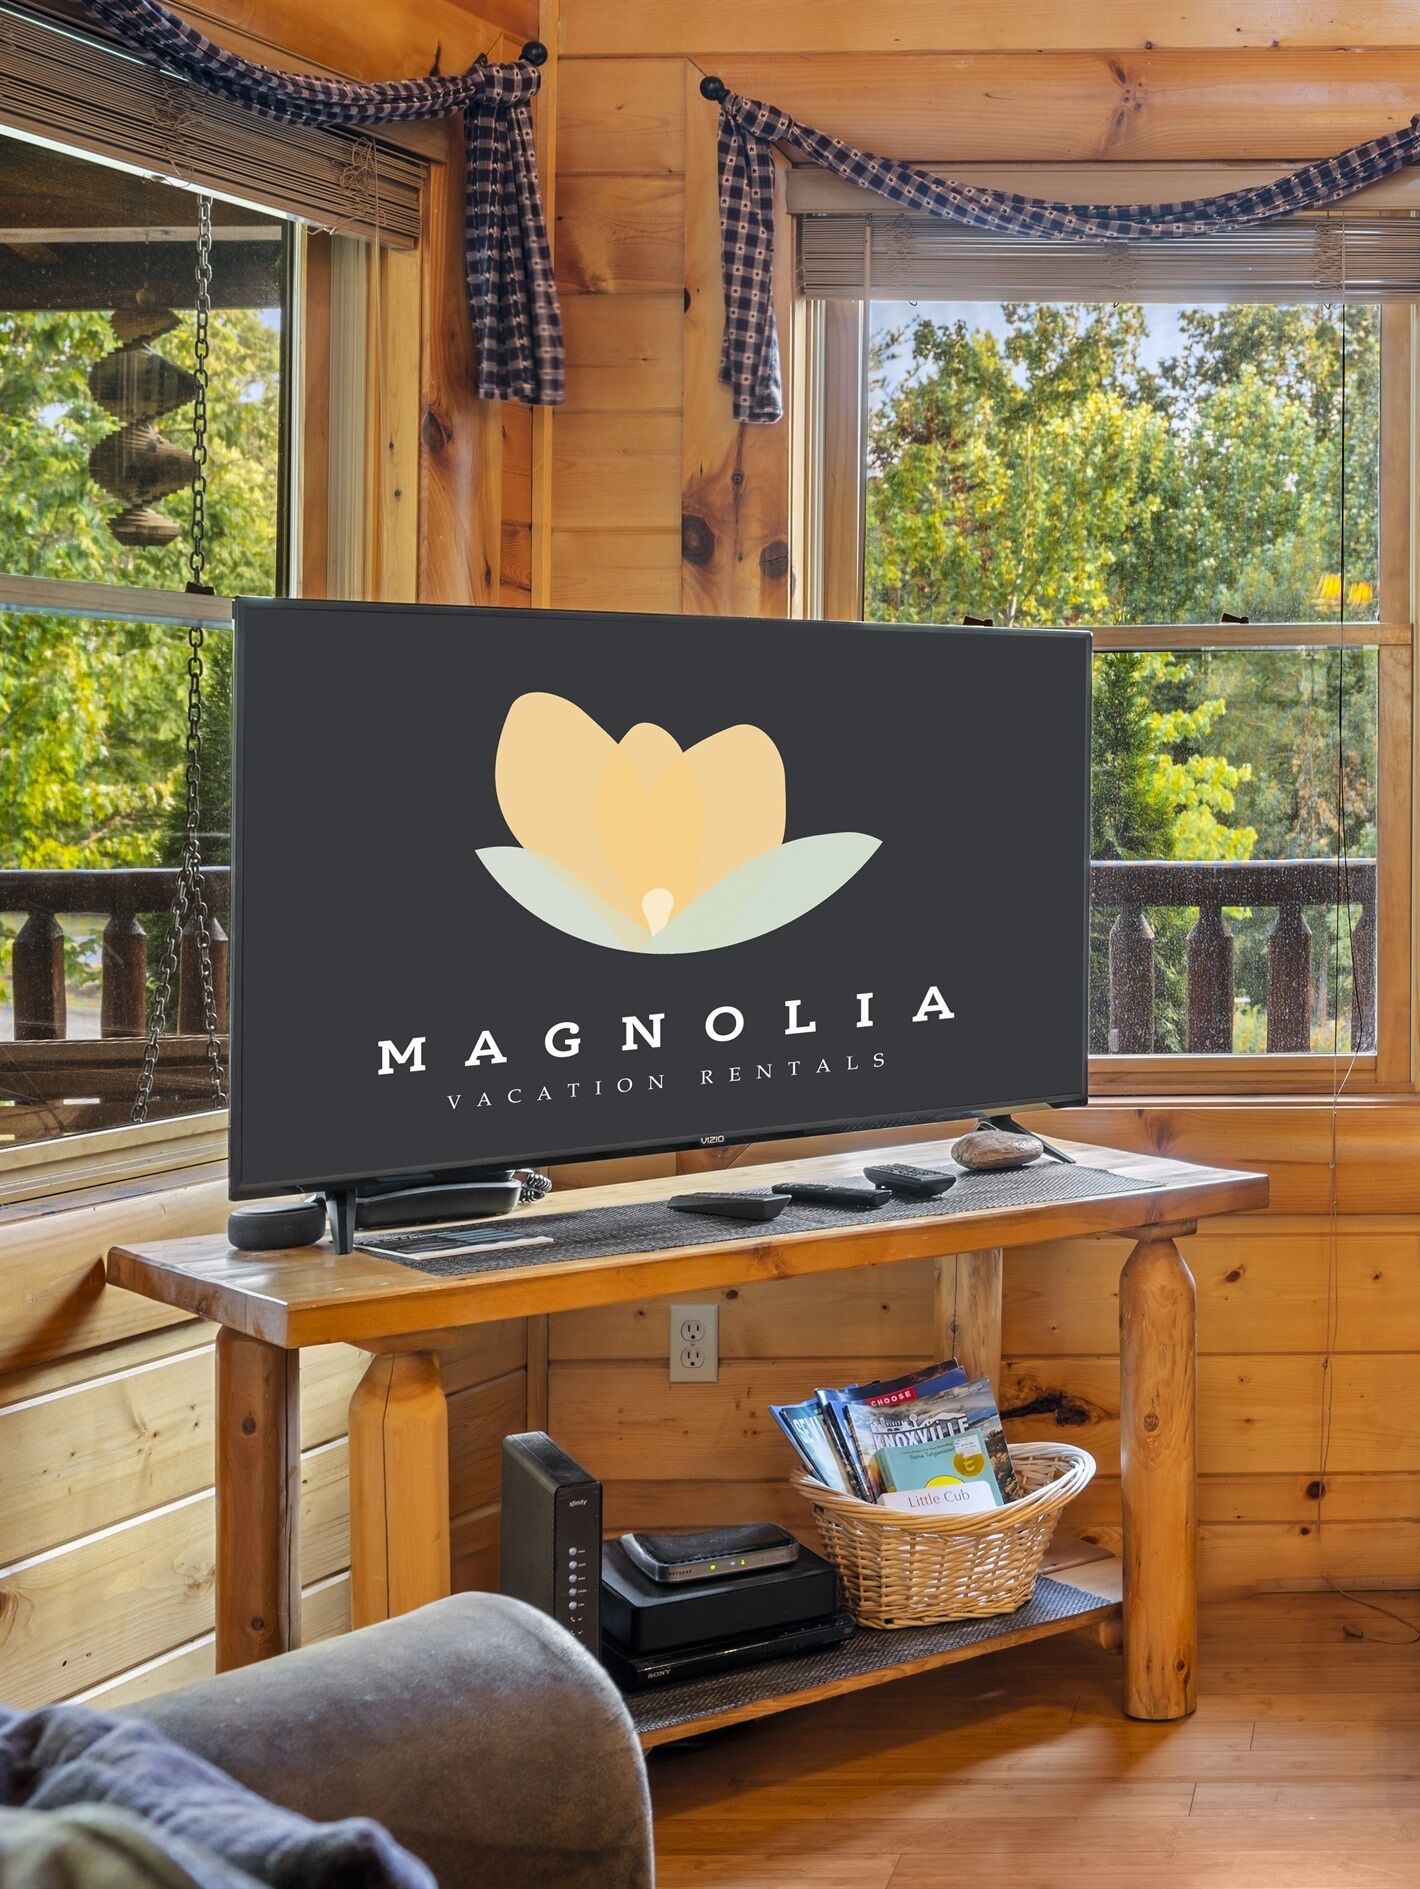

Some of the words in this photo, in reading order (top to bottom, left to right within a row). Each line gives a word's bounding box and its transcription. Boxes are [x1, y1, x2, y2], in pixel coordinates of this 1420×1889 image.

[377, 985, 956, 1076] MAGNOLIA
[446, 1074, 665, 1111] VACATION
[699, 1052, 887, 1086] RENTALS
[700, 1135, 725, 1145] VIZIO
[870, 1390, 912, 1407] CHOOSE
[568, 1499, 588, 1508] xfinity
[907, 1493, 941, 1509] Little
[943, 1489, 970, 1503] Cub
[647, 1668, 671, 1680] SONY
